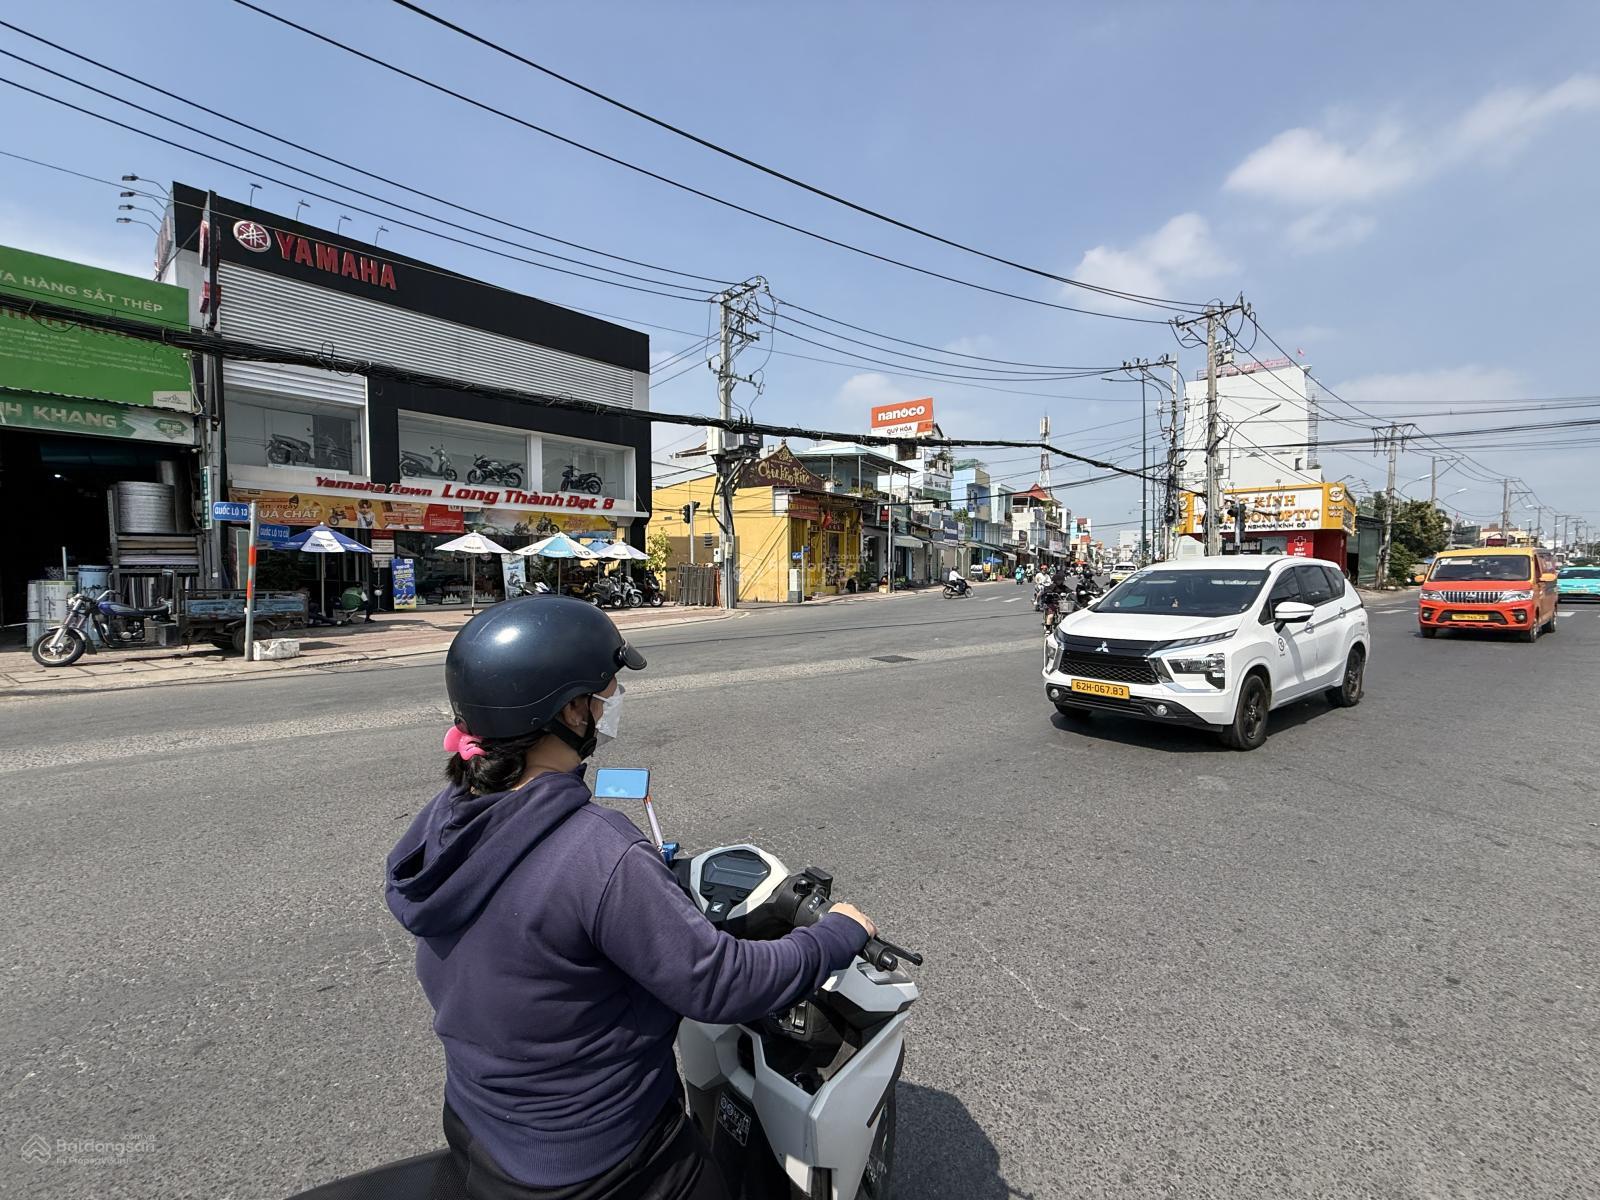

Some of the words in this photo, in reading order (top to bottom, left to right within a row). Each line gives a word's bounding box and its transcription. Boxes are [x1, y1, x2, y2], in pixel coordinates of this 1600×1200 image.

[275, 230, 397, 291] YAMAHA
[22, 276, 78, 295] HÀNG
[32, 405, 117, 428] KHANG
[878, 406, 925, 421] nanoco
[316, 476, 387, 493] Yamaha
[390, 483, 433, 496] Town
[441, 484, 499, 504] Long
[504, 490, 564, 507] Thành
[565, 495, 598, 511] Đạt
[1255, 494, 1296, 508] KÍNH
[214, 504, 230, 515] QUỐC
[231, 507, 240, 516] LỘ
[241, 508, 248, 517] 13
[1275, 509, 1320, 522] OPTIC
